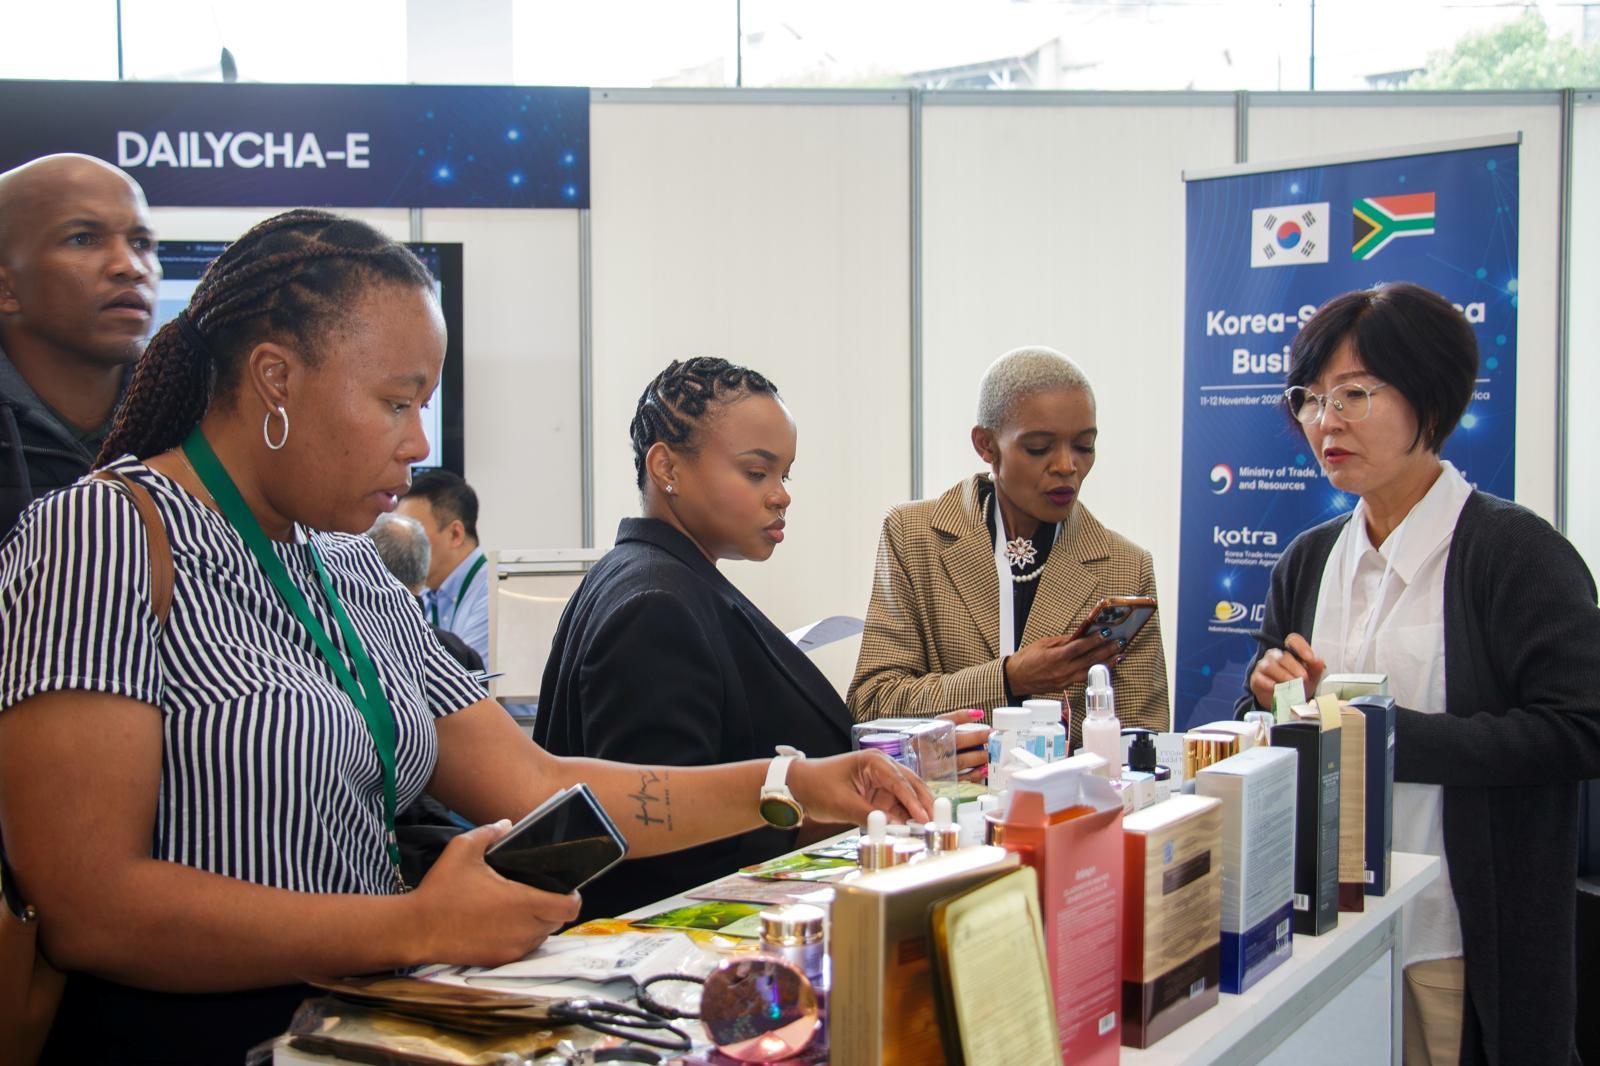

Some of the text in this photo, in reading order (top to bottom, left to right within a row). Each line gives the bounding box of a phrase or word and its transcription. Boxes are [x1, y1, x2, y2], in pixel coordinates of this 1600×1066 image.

[116, 130, 371, 169] DAILYCHA-E
[1206, 303, 1318, 337] Korea-S
[1232, 344, 1291, 375] Busi
[1200, 395, 1218, 406] 11-12
[1219, 394, 1259, 406] November
[1239, 466, 1274, 479] Ministry
[1275, 466, 1287, 477] of
[1287, 466, 1318, 478] Trade,
[1238, 480, 1306, 491] and Resources
[1213, 525, 1278, 548] kotra
[1250, 603, 1266, 622] ID
